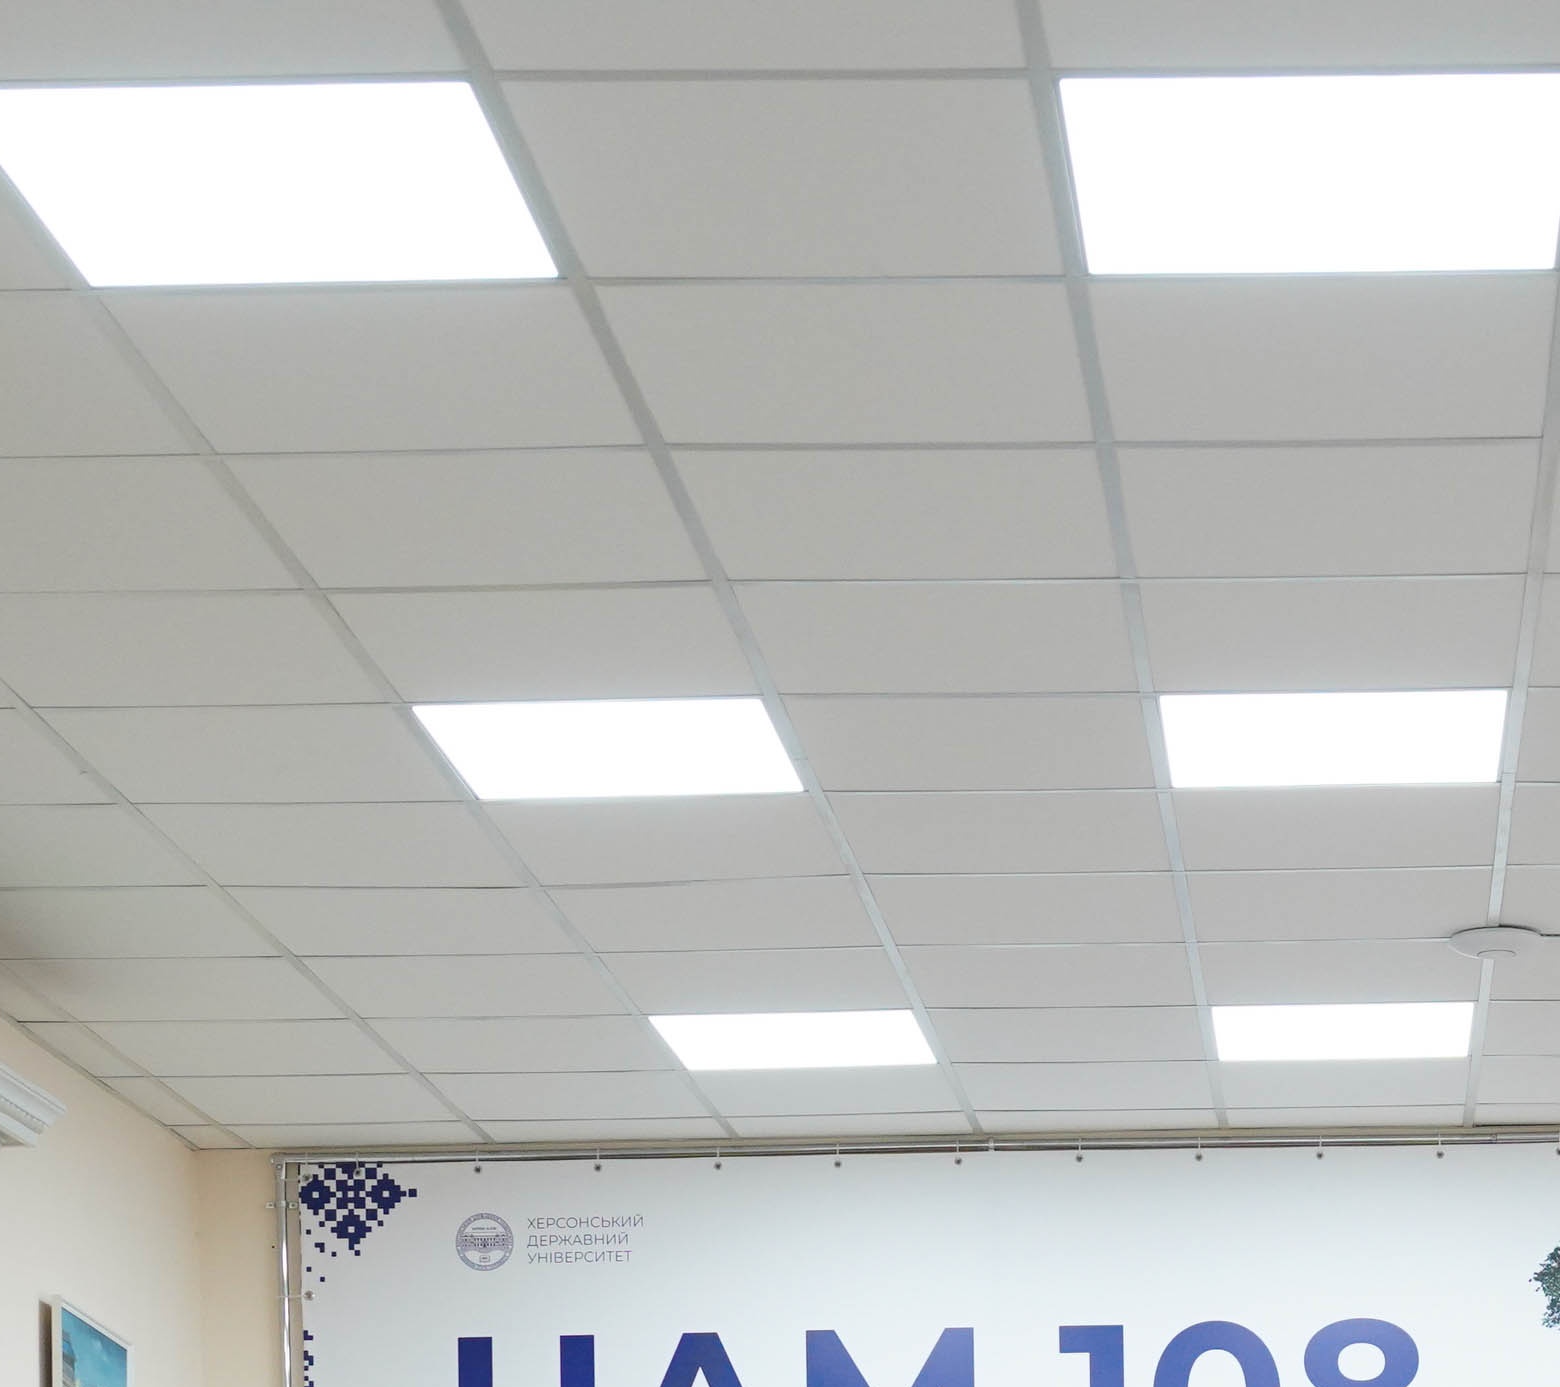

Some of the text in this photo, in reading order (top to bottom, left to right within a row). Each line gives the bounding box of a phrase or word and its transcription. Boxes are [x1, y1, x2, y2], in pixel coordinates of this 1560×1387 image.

[527, 1213, 645, 1230] ХЕРСОНСЬКИЙ
[527, 1232, 630, 1248] ДЕРЖАВНИЙ
[527, 1250, 633, 1264] УНІВЕРСИТЕТ
